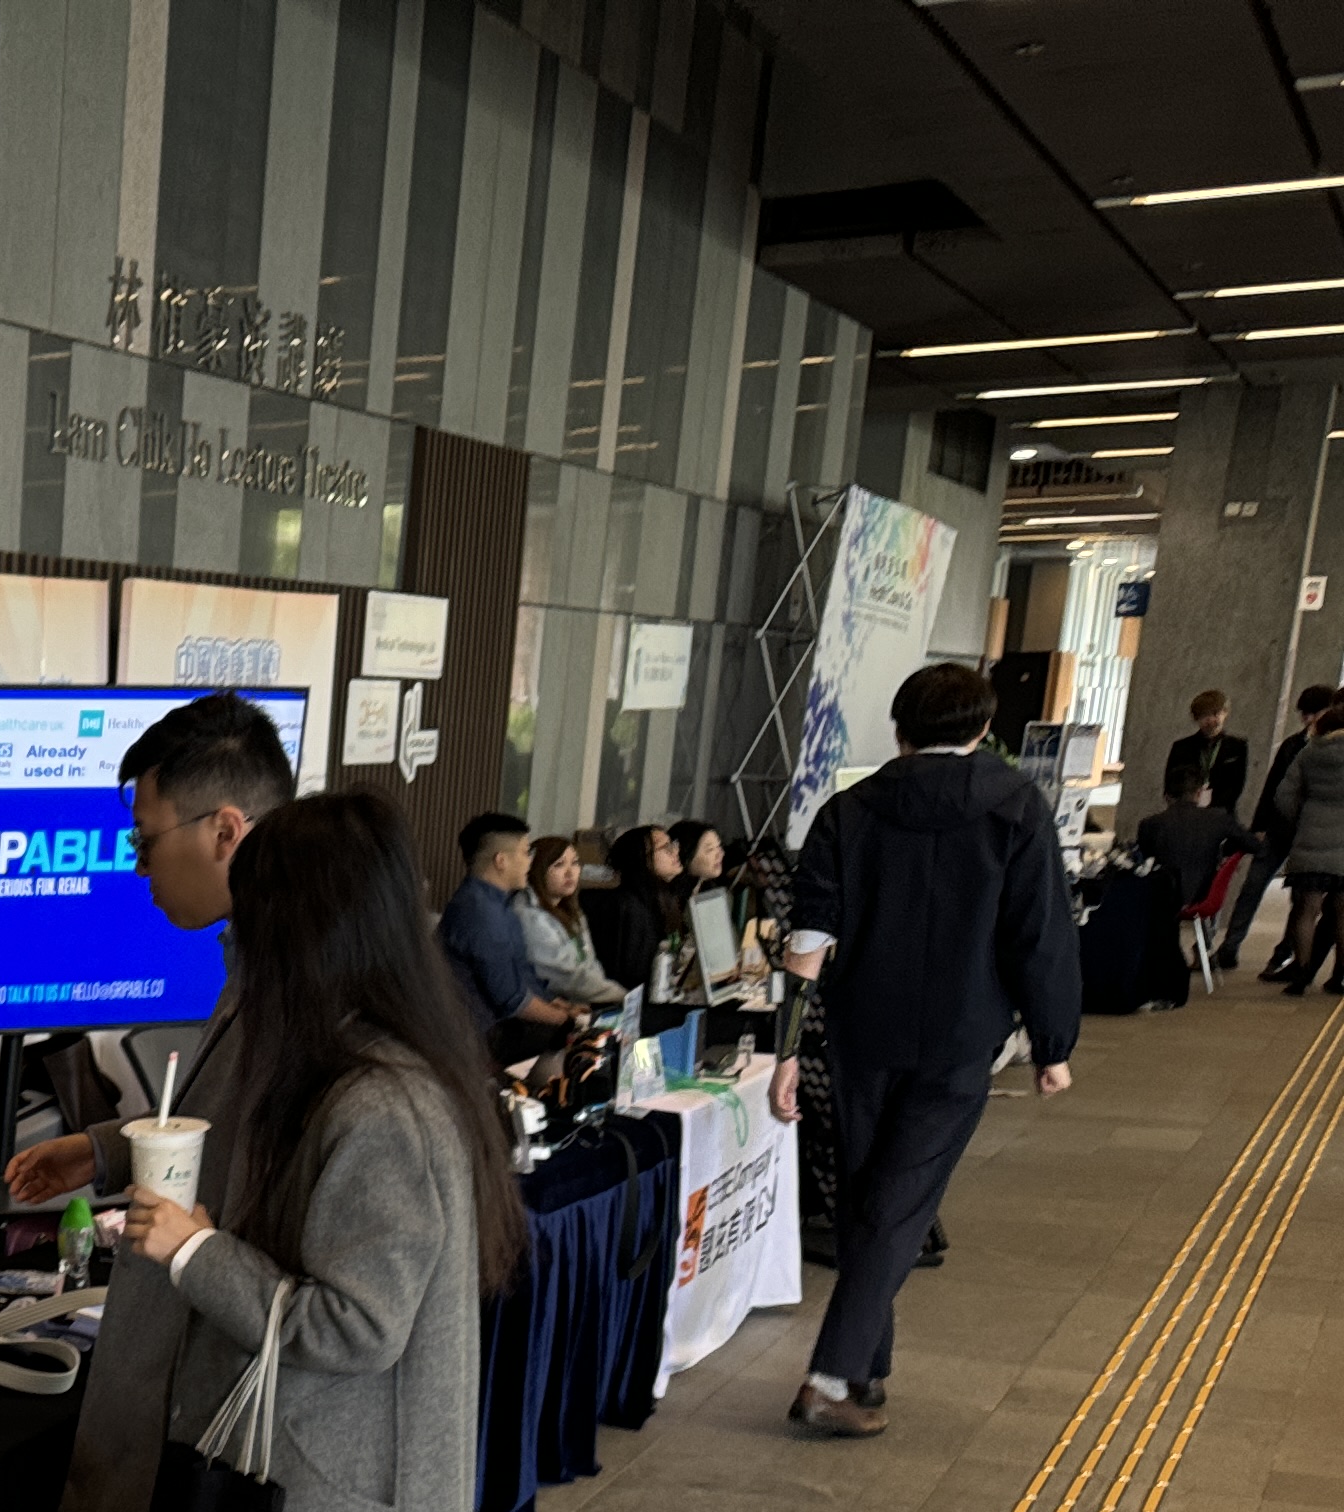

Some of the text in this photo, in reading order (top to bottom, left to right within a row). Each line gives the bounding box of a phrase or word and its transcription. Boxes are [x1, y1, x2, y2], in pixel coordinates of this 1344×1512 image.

[26, 745, 86, 760] Already
[24, 764, 63, 778] used
[67, 764, 85, 777] in:
